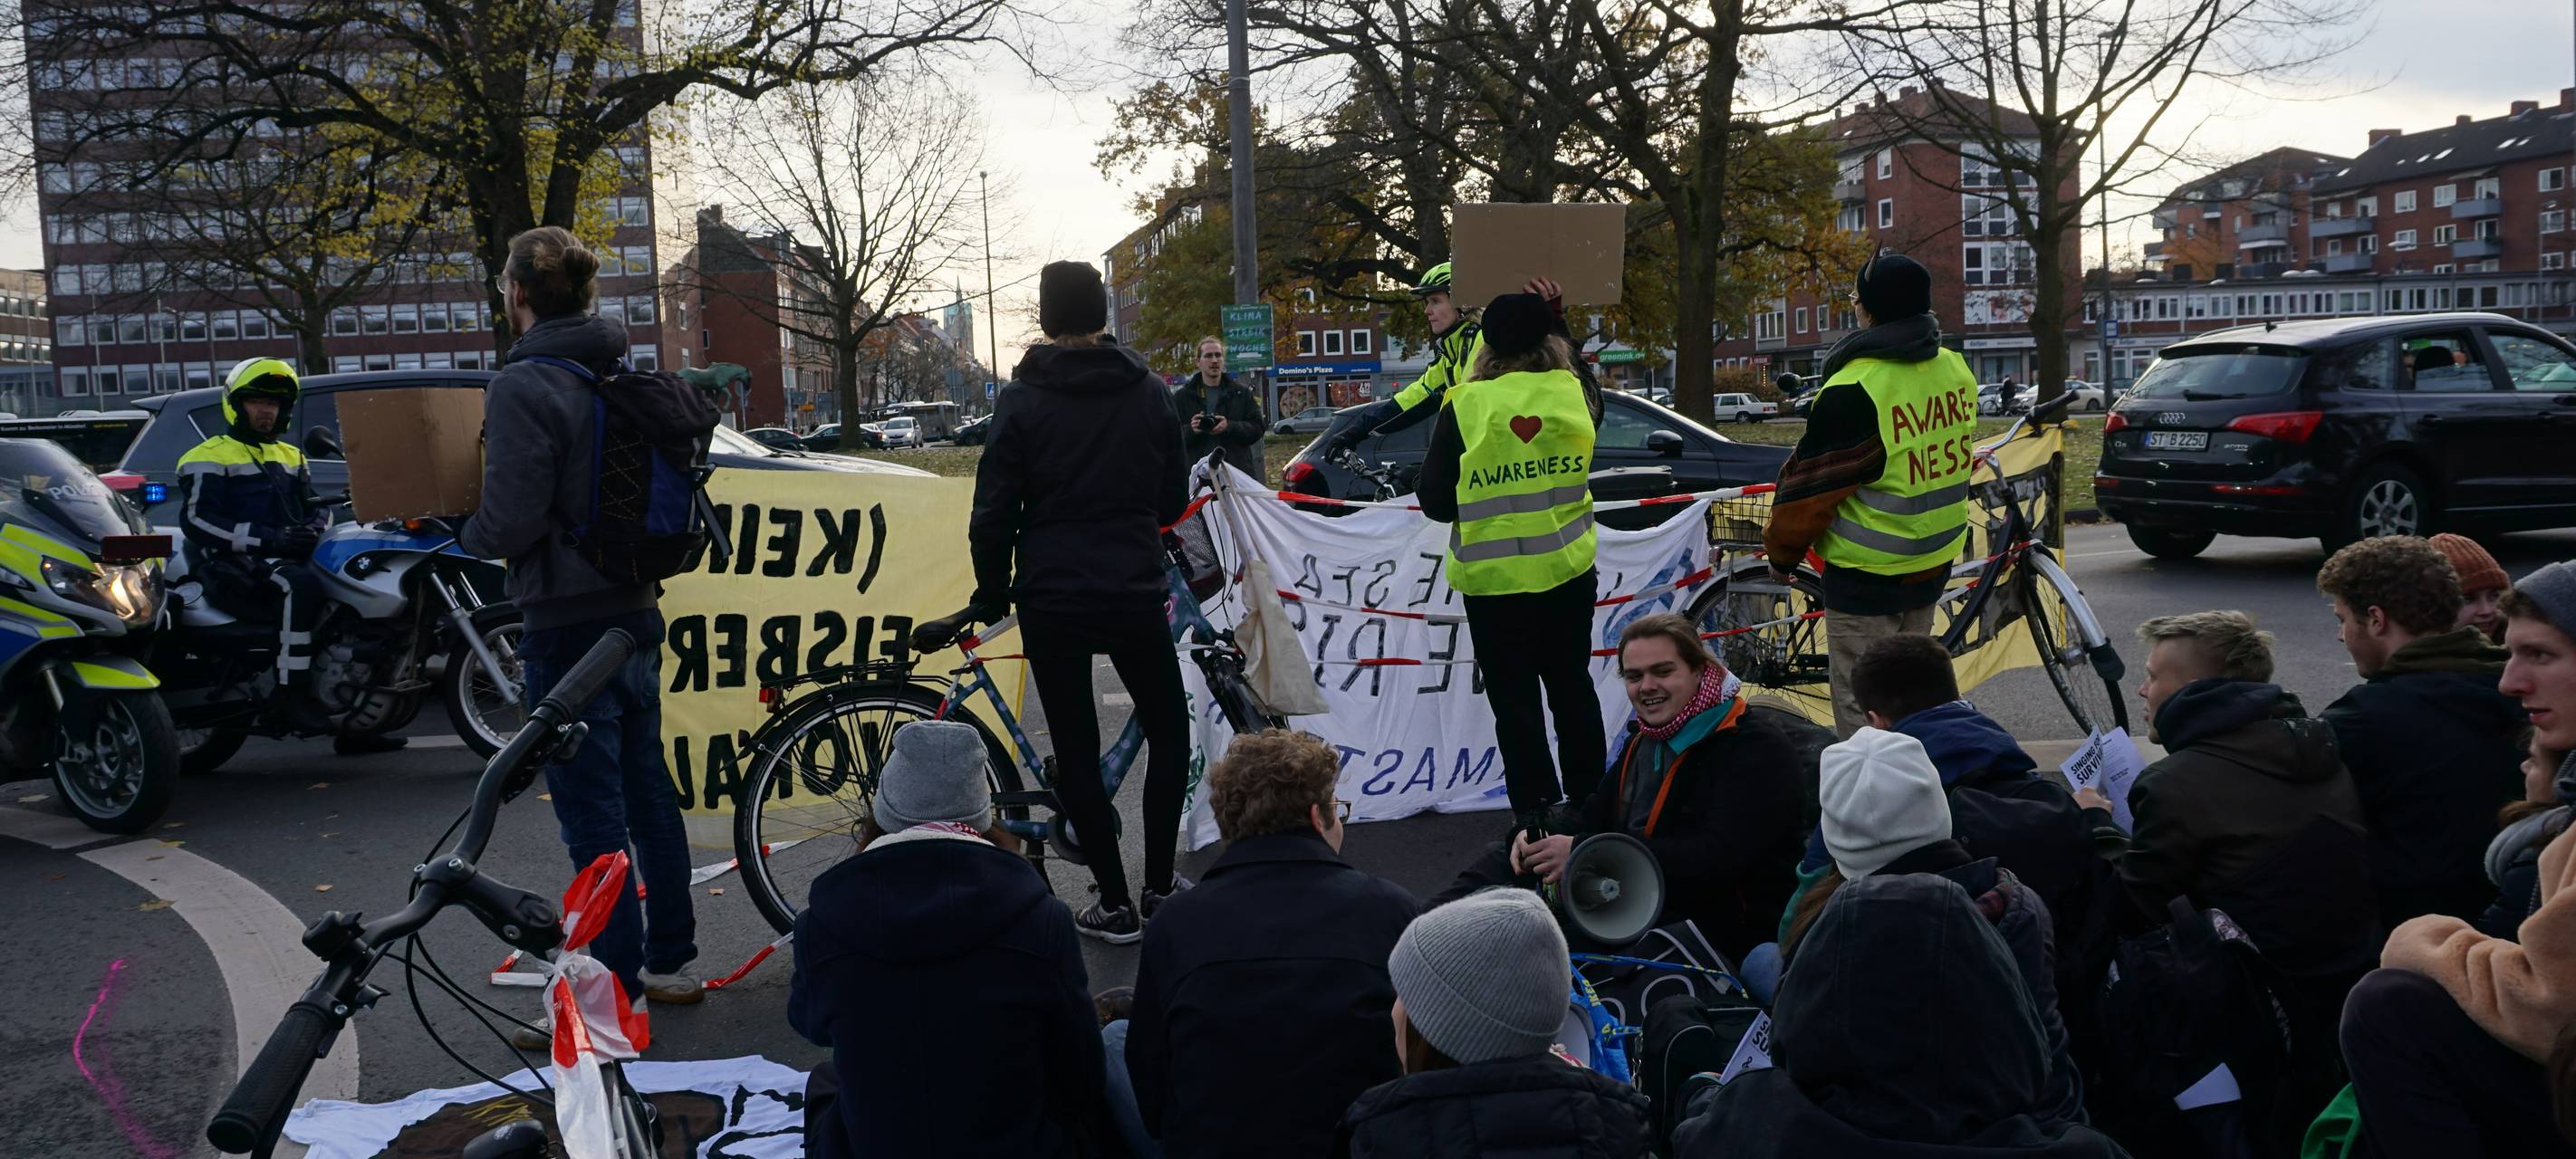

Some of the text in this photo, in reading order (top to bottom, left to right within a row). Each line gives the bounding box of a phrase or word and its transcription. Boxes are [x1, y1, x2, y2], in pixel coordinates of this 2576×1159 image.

[1229, 311, 1262, 321] KLIMA
[1228, 326, 1265, 338] STREIK
[1229, 343, 1266, 352] WOCHE
[1278, 367, 1312, 375] Domino's
[1891, 387, 1973, 444] AWARE-
[2151, 432, 2206, 446] ST B 2250
[1908, 435, 1971, 485] NESS
[1468, 455, 1584, 490] AWARENESS
[2071, 745, 2096, 775] SINGING
